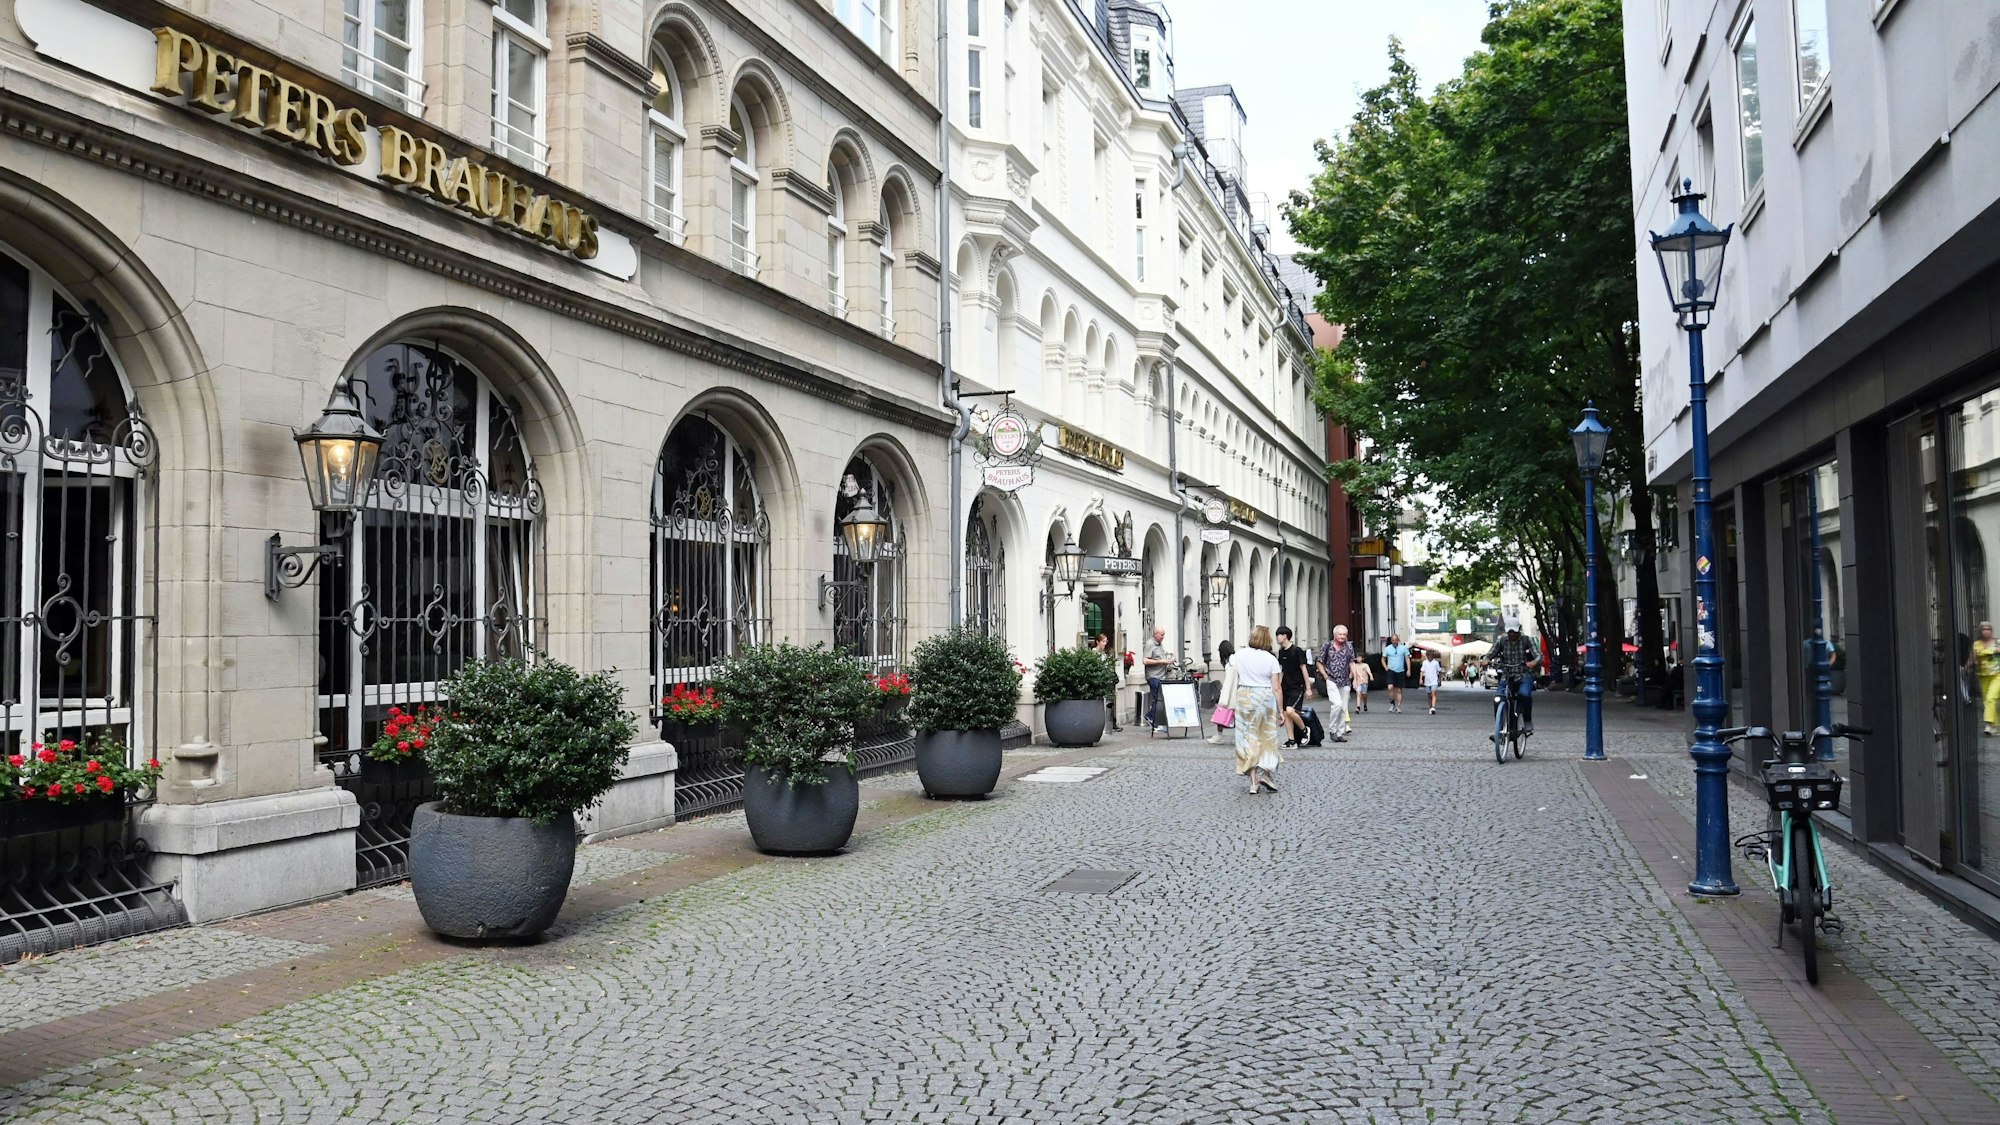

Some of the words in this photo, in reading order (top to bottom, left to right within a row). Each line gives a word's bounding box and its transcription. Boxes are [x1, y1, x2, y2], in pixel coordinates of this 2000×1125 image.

[150, 26, 367, 166] PETERS
[377, 125, 599, 260] BRAUHAUS
[987, 473, 1030, 486] BRAUHAUS
[1104, 558, 1136, 571] PETERS
